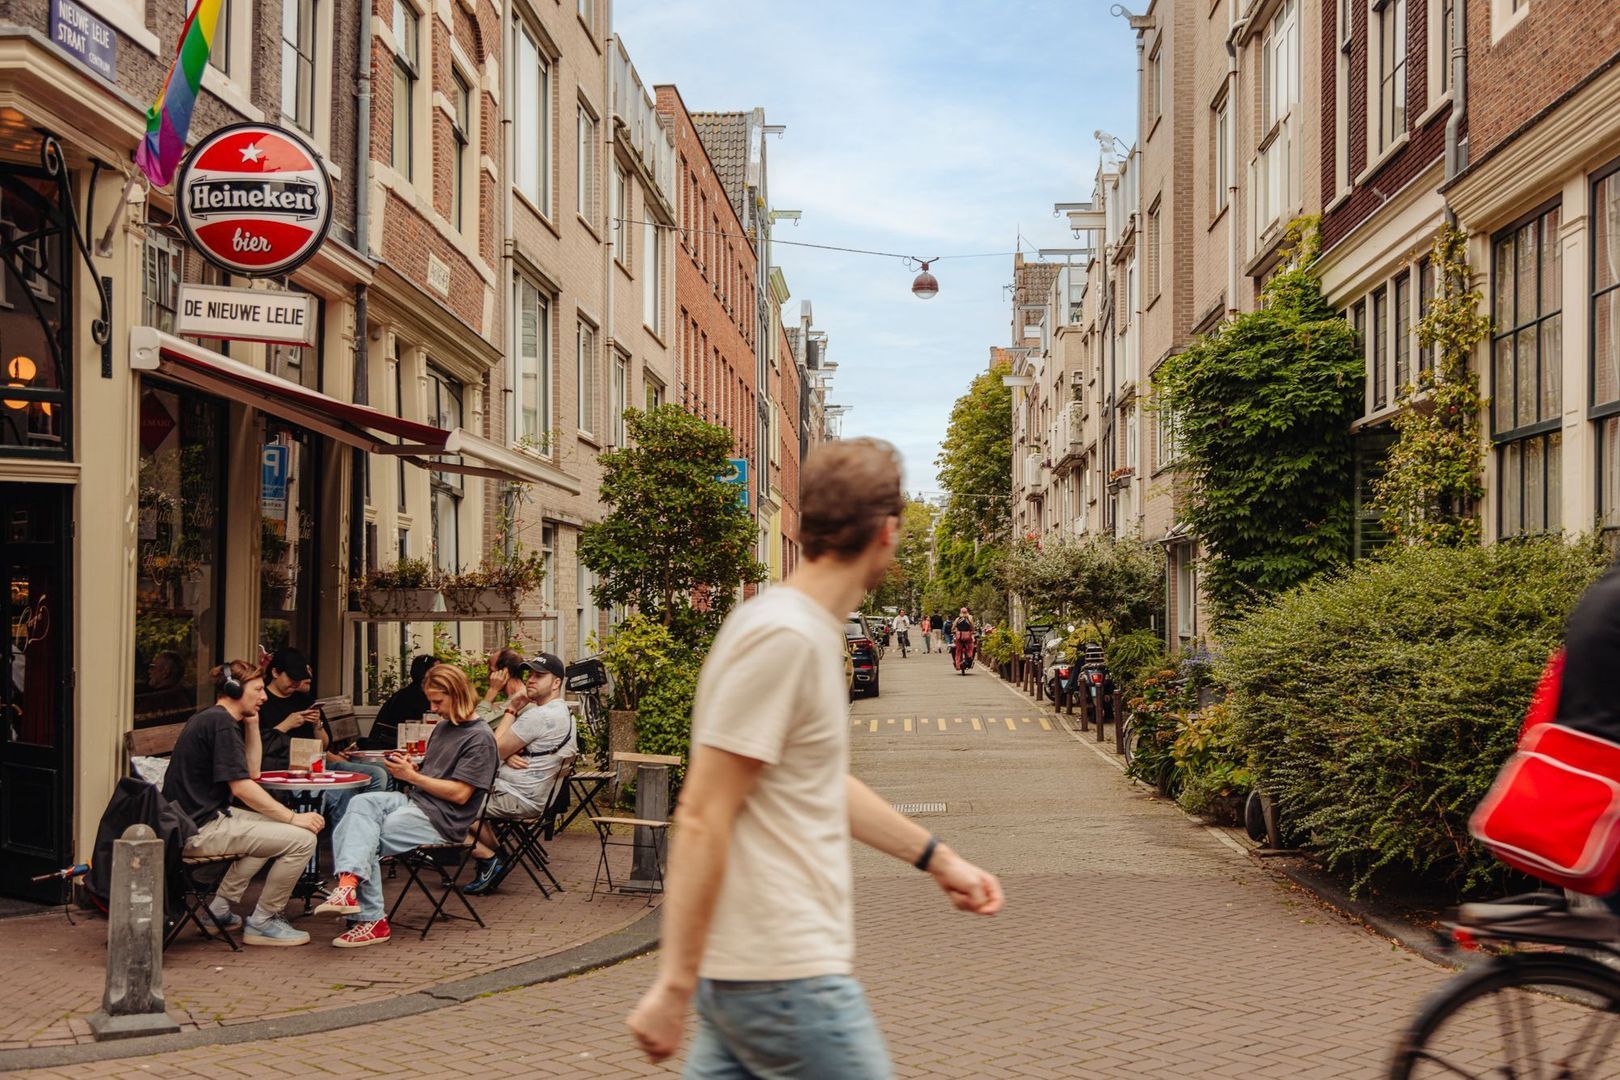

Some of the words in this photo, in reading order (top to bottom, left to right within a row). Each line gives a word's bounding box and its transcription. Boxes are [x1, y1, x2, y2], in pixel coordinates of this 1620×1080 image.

[58, 22, 86, 54] STRAAT
[59, 0, 89, 35] NIEUWE
[92, 22, 110, 49] LELIE
[193, 184, 314, 211] Heineken
[232, 227, 272, 253] bier
[184, 299, 203, 317] DE
[207, 301, 261, 322] NIEUWE
[266, 306, 304, 326] LELIE
